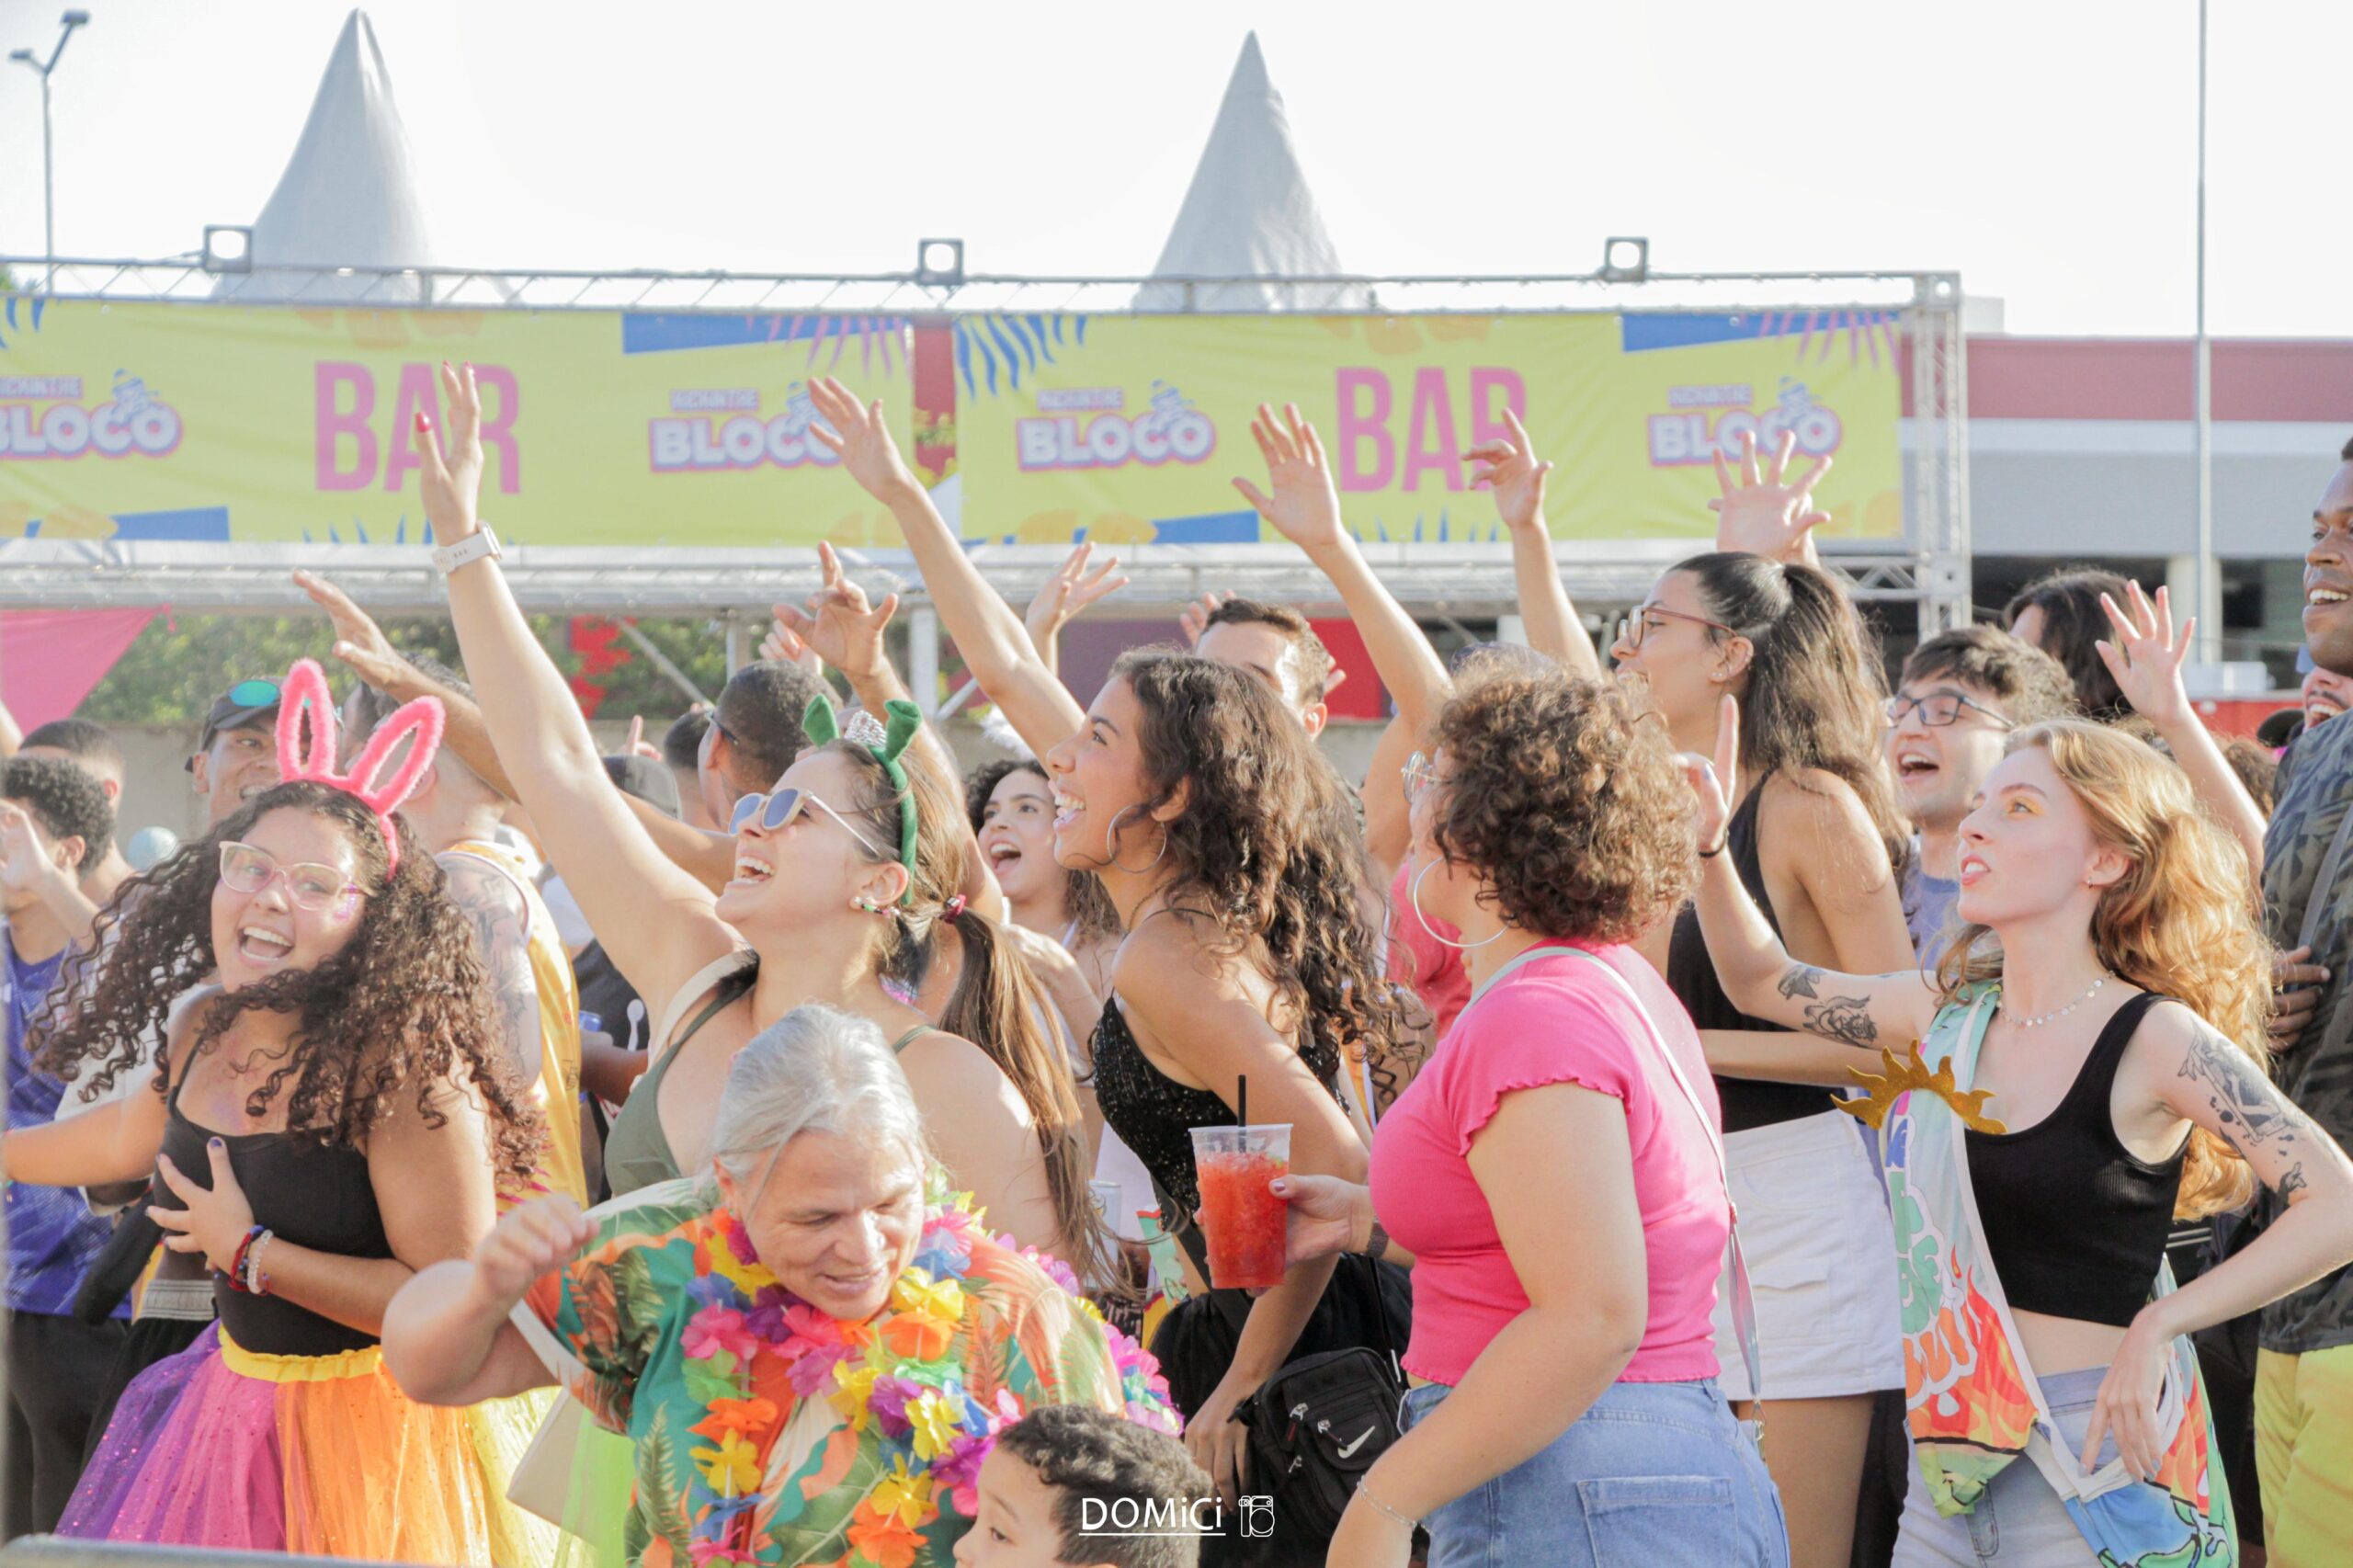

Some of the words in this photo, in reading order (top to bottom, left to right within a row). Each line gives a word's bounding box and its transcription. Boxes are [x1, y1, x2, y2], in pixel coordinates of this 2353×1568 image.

[0, 402, 183, 460] LOCO
[314, 361, 521, 494] BAR
[1017, 412, 1216, 472] BLOCO
[1336, 367, 1527, 492] BAR
[1649, 408, 1841, 467] BLOCO
